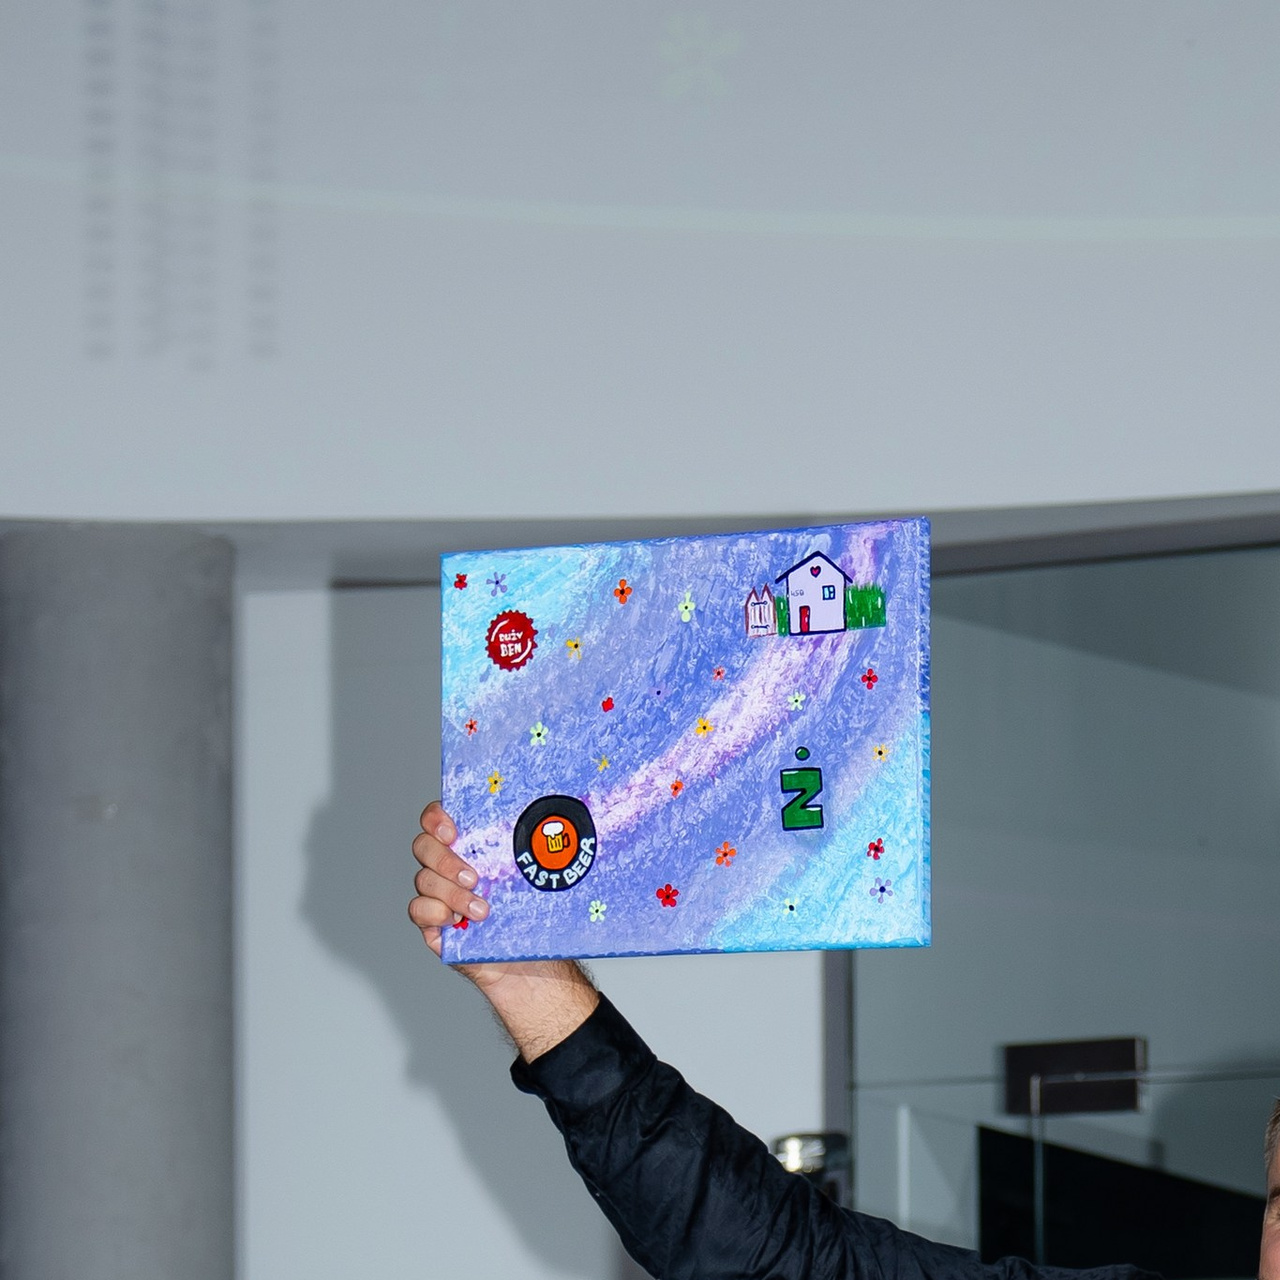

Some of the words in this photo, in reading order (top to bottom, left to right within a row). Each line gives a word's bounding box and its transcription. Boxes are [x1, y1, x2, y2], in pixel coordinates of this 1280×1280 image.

[500, 643, 522, 657] BEN
[516, 851, 560, 889] FAST
[562, 837, 596, 885] BEER
